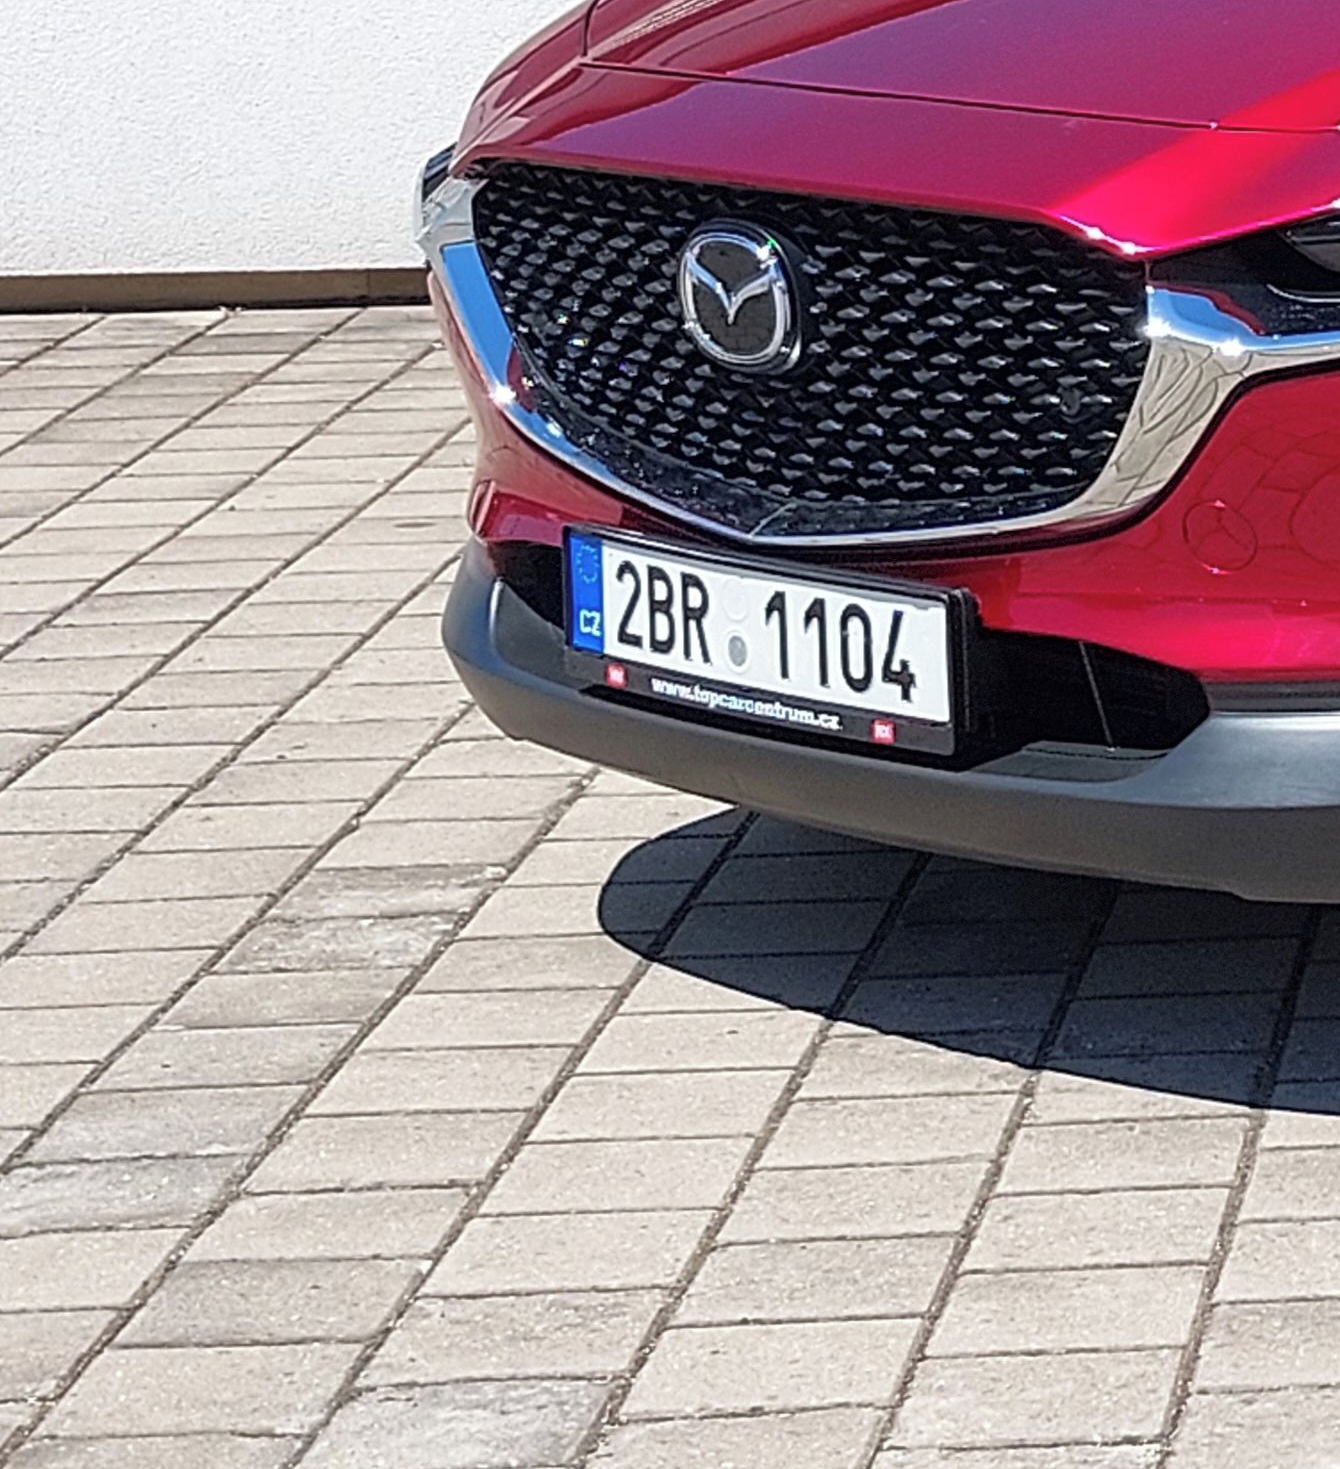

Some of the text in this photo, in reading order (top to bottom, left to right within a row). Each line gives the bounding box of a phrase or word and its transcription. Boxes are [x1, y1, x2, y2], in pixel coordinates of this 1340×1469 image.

[579, 609, 602, 636] CZ
[616, 560, 916, 702] 2BR 1104
[652, 677, 840, 730] www.topcarcentrum.cz
